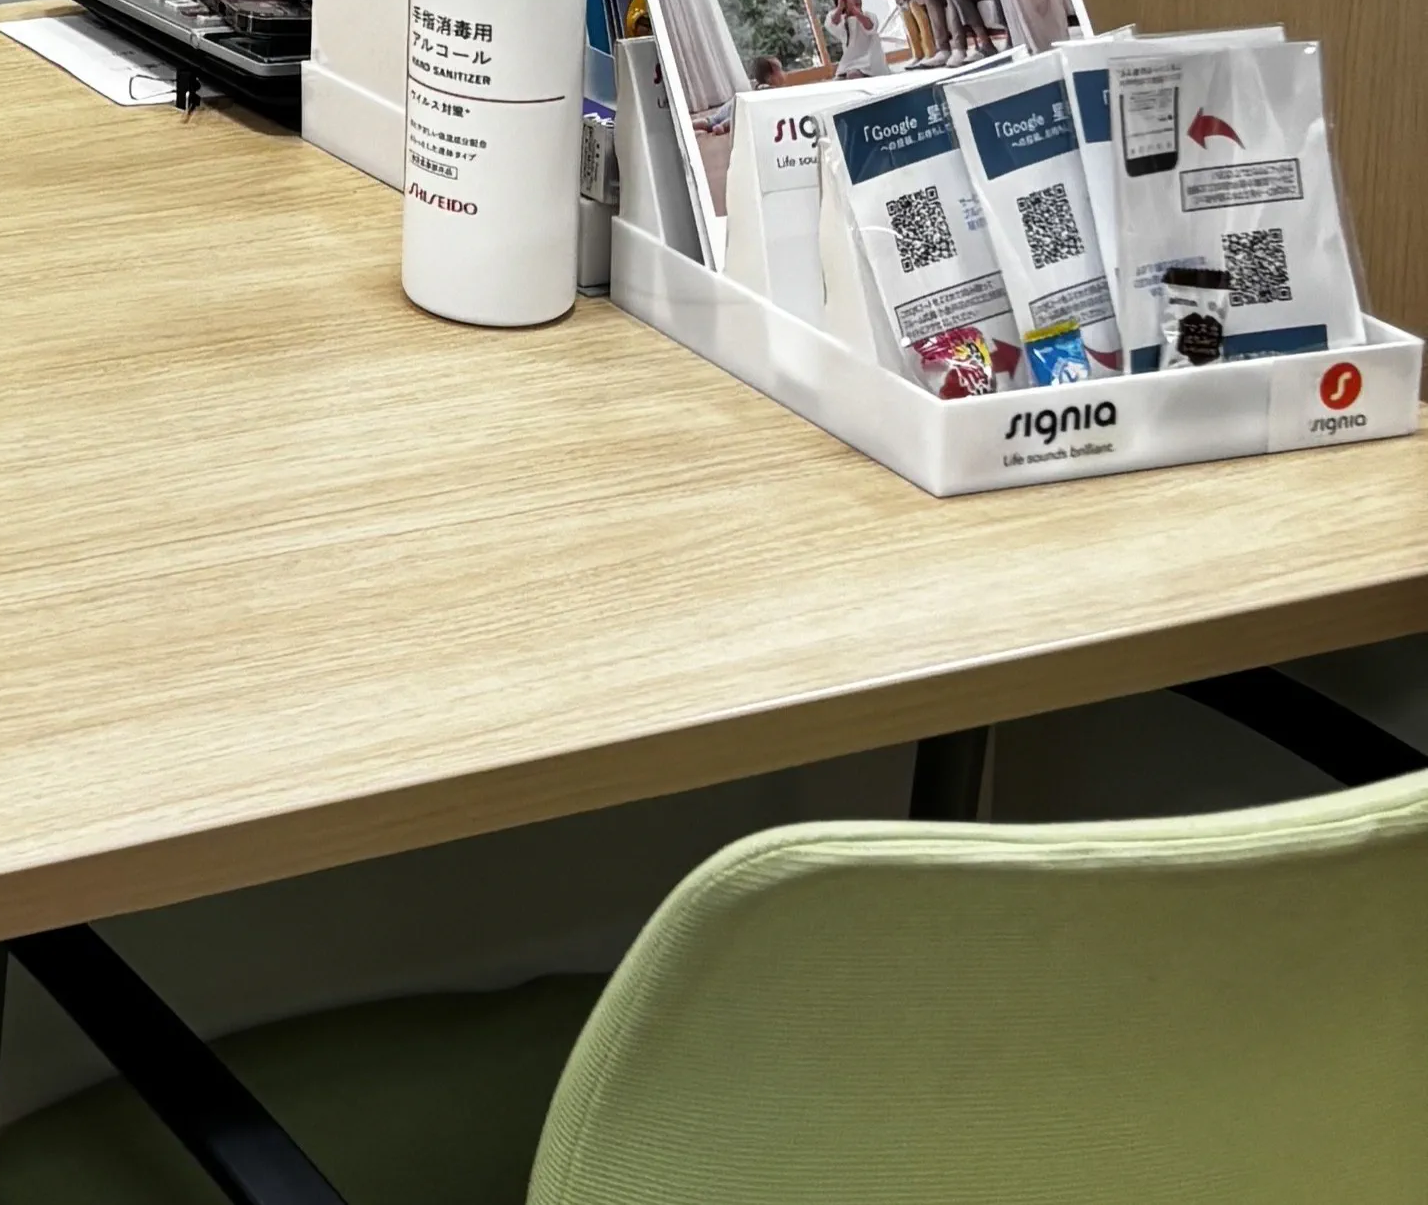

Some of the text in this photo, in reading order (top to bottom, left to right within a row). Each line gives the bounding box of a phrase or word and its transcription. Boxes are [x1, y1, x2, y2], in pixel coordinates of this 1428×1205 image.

[412, 6, 493, 43] 手指消毒用
[412, 31, 492, 65] アルコール
[433, 66, 491, 86] SANITIZER
[774, 115, 820, 148] sig
[777, 155, 819, 169] Life sou
[409, 182, 478, 215] SHISEIDO
[1004, 400, 1117, 445] signia
[1308, 412, 1367, 436] signia
[1003, 452, 1025, 467] Life
[1027, 448, 1067, 464] sounds
